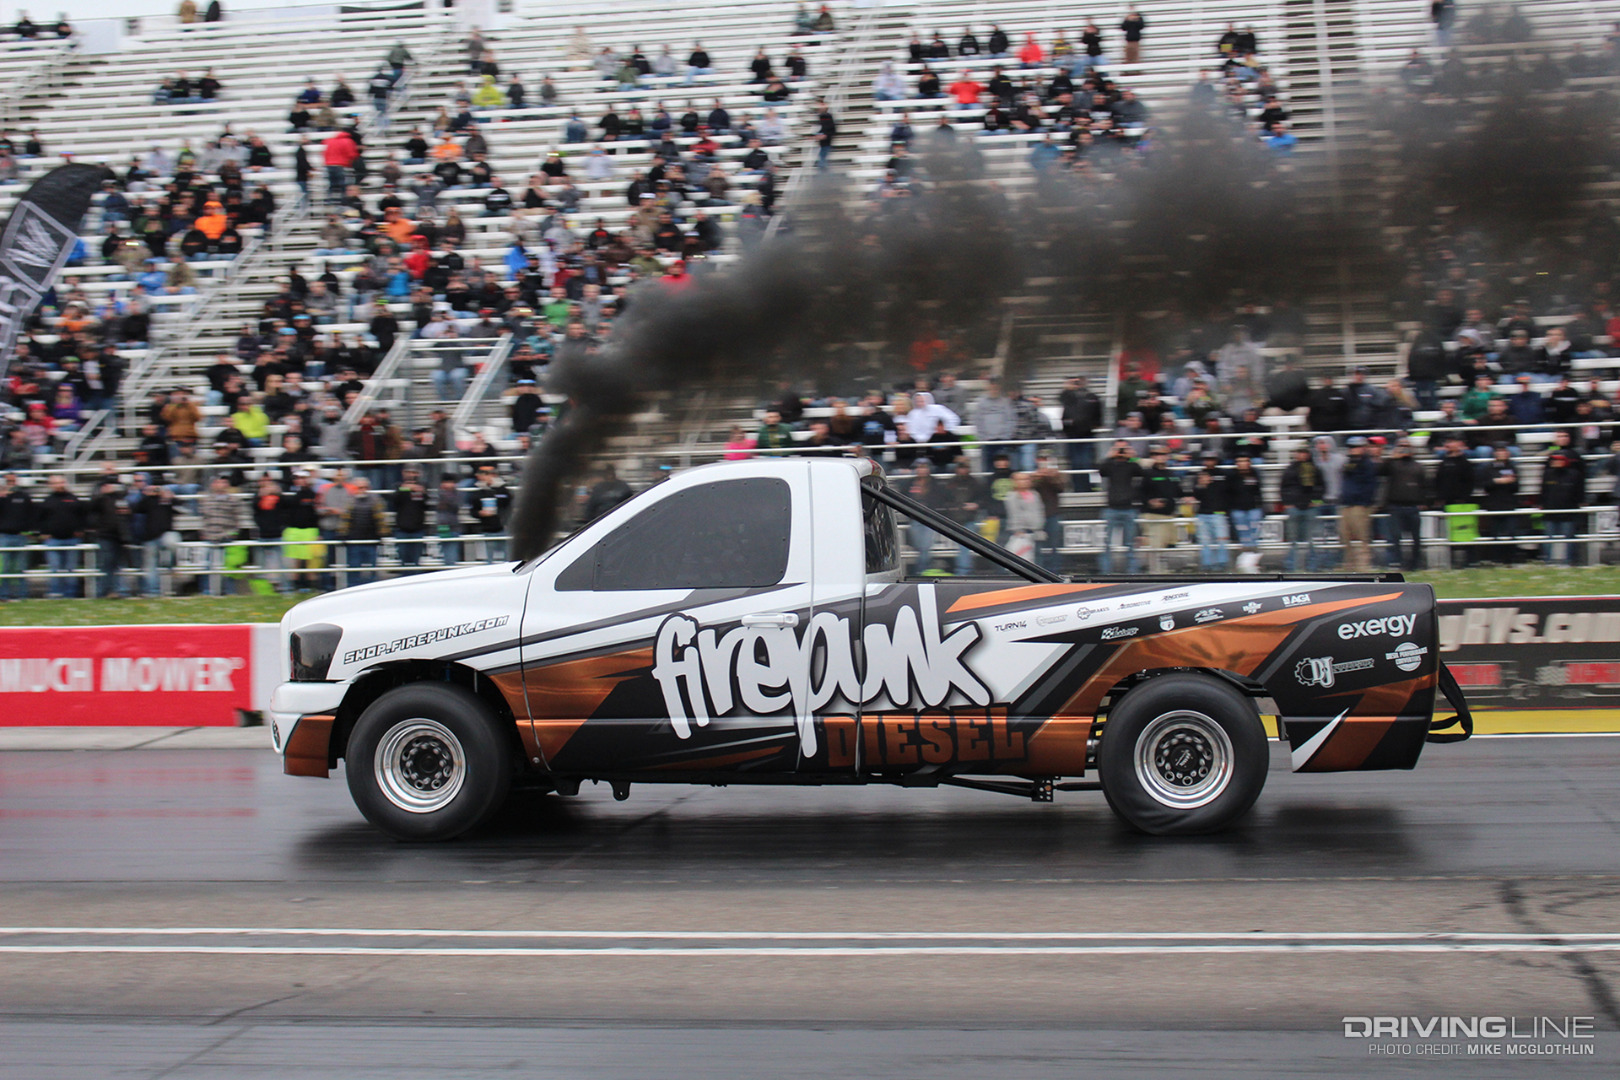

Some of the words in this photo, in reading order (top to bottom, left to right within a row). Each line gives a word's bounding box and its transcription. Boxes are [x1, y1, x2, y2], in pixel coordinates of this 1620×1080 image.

[1290, 593, 1312, 605] AGI
[343, 614, 510, 665] SHOP.FIREPUNK.COM
[994, 620, 1028, 632] TURN14
[1337, 613, 1417, 640] exergy
[0, 657, 94, 692] MUCH
[651, 583, 994, 759] firepunk
[822, 706, 1026, 768] DIESEL
